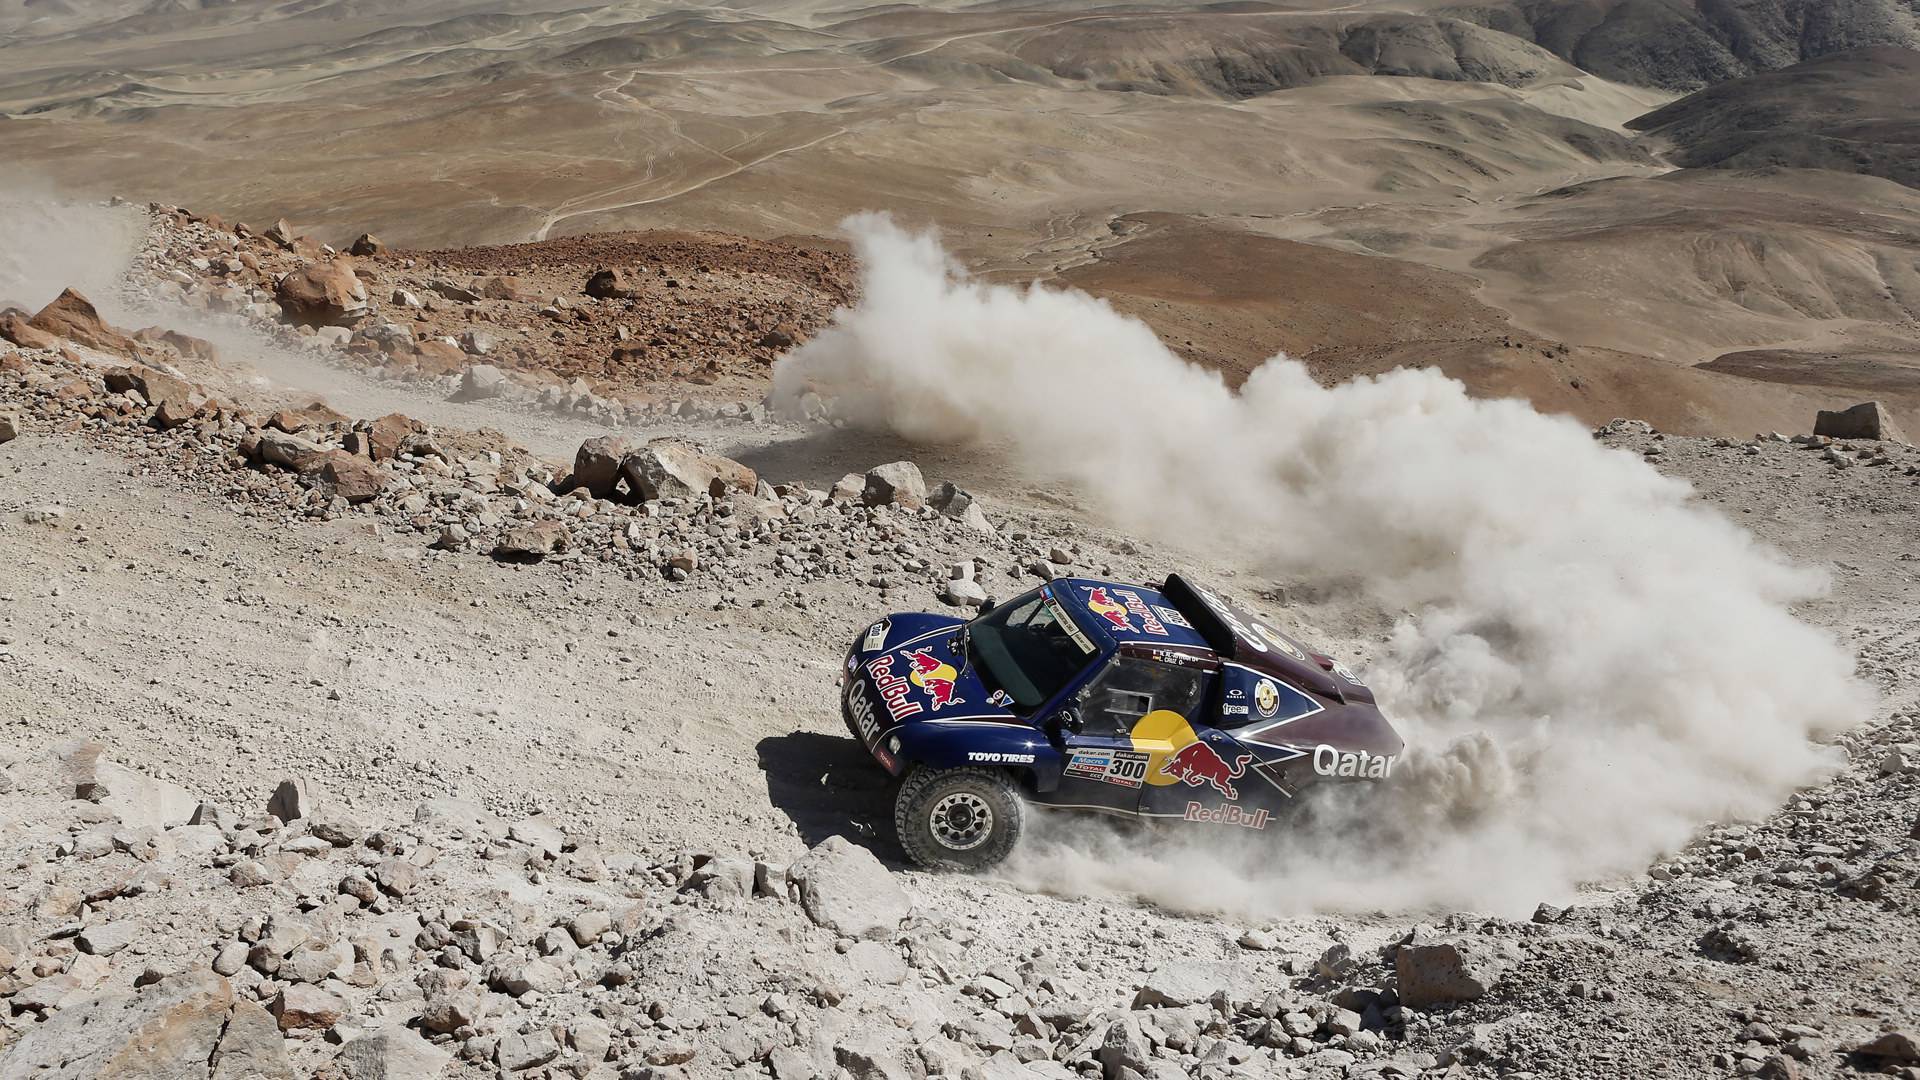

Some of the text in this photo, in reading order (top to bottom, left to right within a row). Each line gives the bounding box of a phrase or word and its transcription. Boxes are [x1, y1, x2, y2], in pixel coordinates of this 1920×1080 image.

[849, 679, 880, 741] Qatar
[968, 752, 1035, 763] TOYO TIRES
[1115, 752, 1148, 760] dakar.com
[1078, 757, 1104, 765] Macro
[1314, 744, 1397, 779] Qatar
[1079, 764, 1105, 772] TOTAL
[1109, 760, 1146, 779] 300
[1112, 778, 1134, 786] TOTAL
